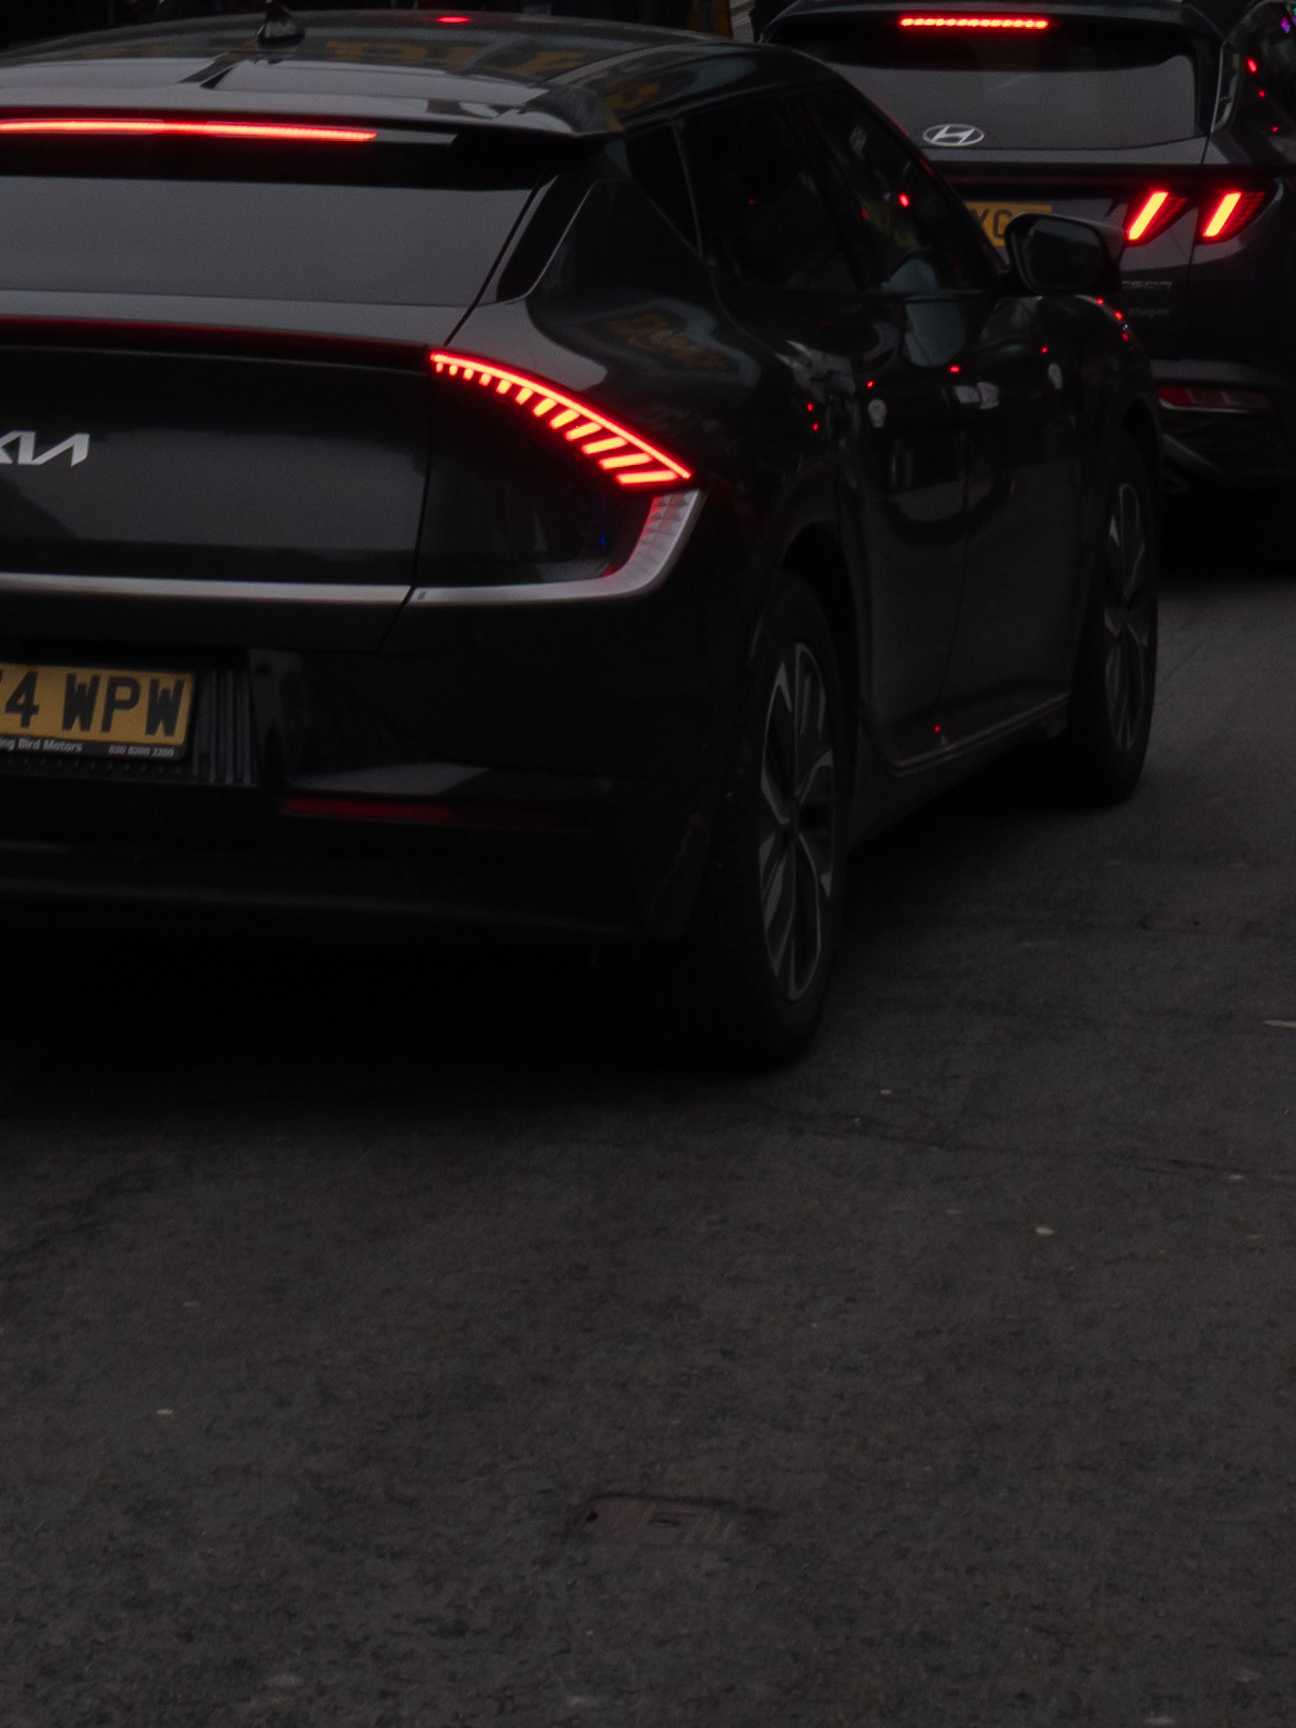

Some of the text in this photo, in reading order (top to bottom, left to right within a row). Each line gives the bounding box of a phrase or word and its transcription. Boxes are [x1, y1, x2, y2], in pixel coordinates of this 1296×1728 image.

[61, 672, 184, 738] WPW
[18, 736, 41, 750] Bird
[43, 740, 83, 753] Motors
